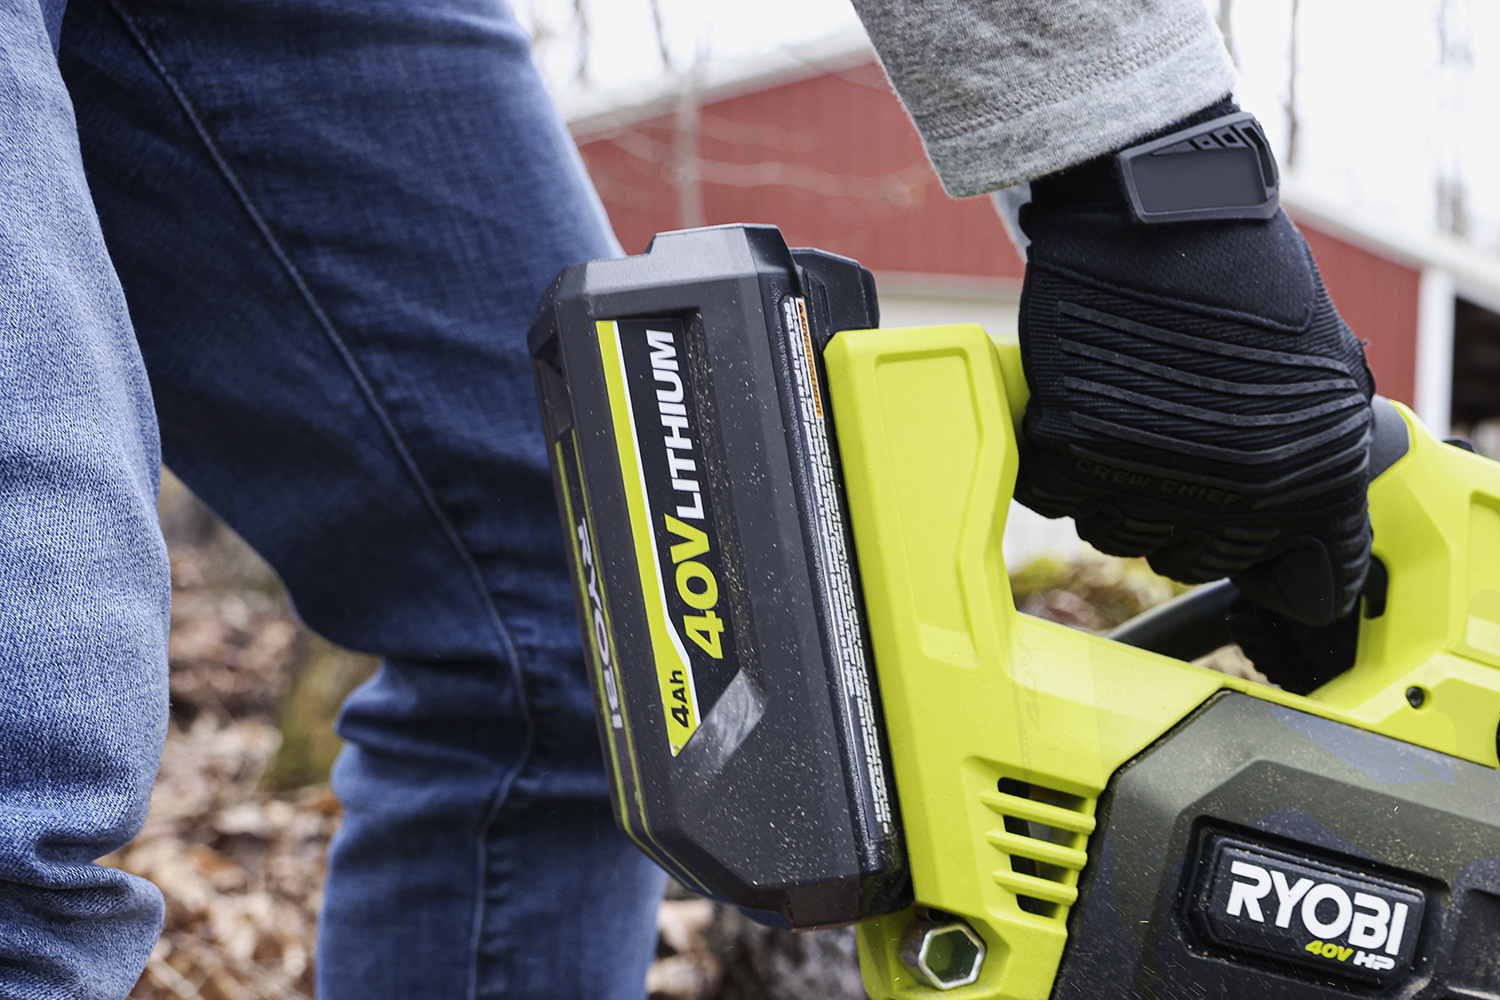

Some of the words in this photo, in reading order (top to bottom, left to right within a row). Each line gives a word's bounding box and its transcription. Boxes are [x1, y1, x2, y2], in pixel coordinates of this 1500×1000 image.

[646, 329, 705, 520] LITHIUM
[1075, 458, 1151, 487] CREW
[1161, 479, 1243, 506] CHIEF
[576, 516, 623, 731] RYOBI
[664, 513, 724, 660] 40V
[669, 669, 689, 729] 4Ah
[1226, 860, 1409, 956] RYOBI
[1305, 940, 1354, 962] 40V
[1353, 950, 1396, 971] HP
